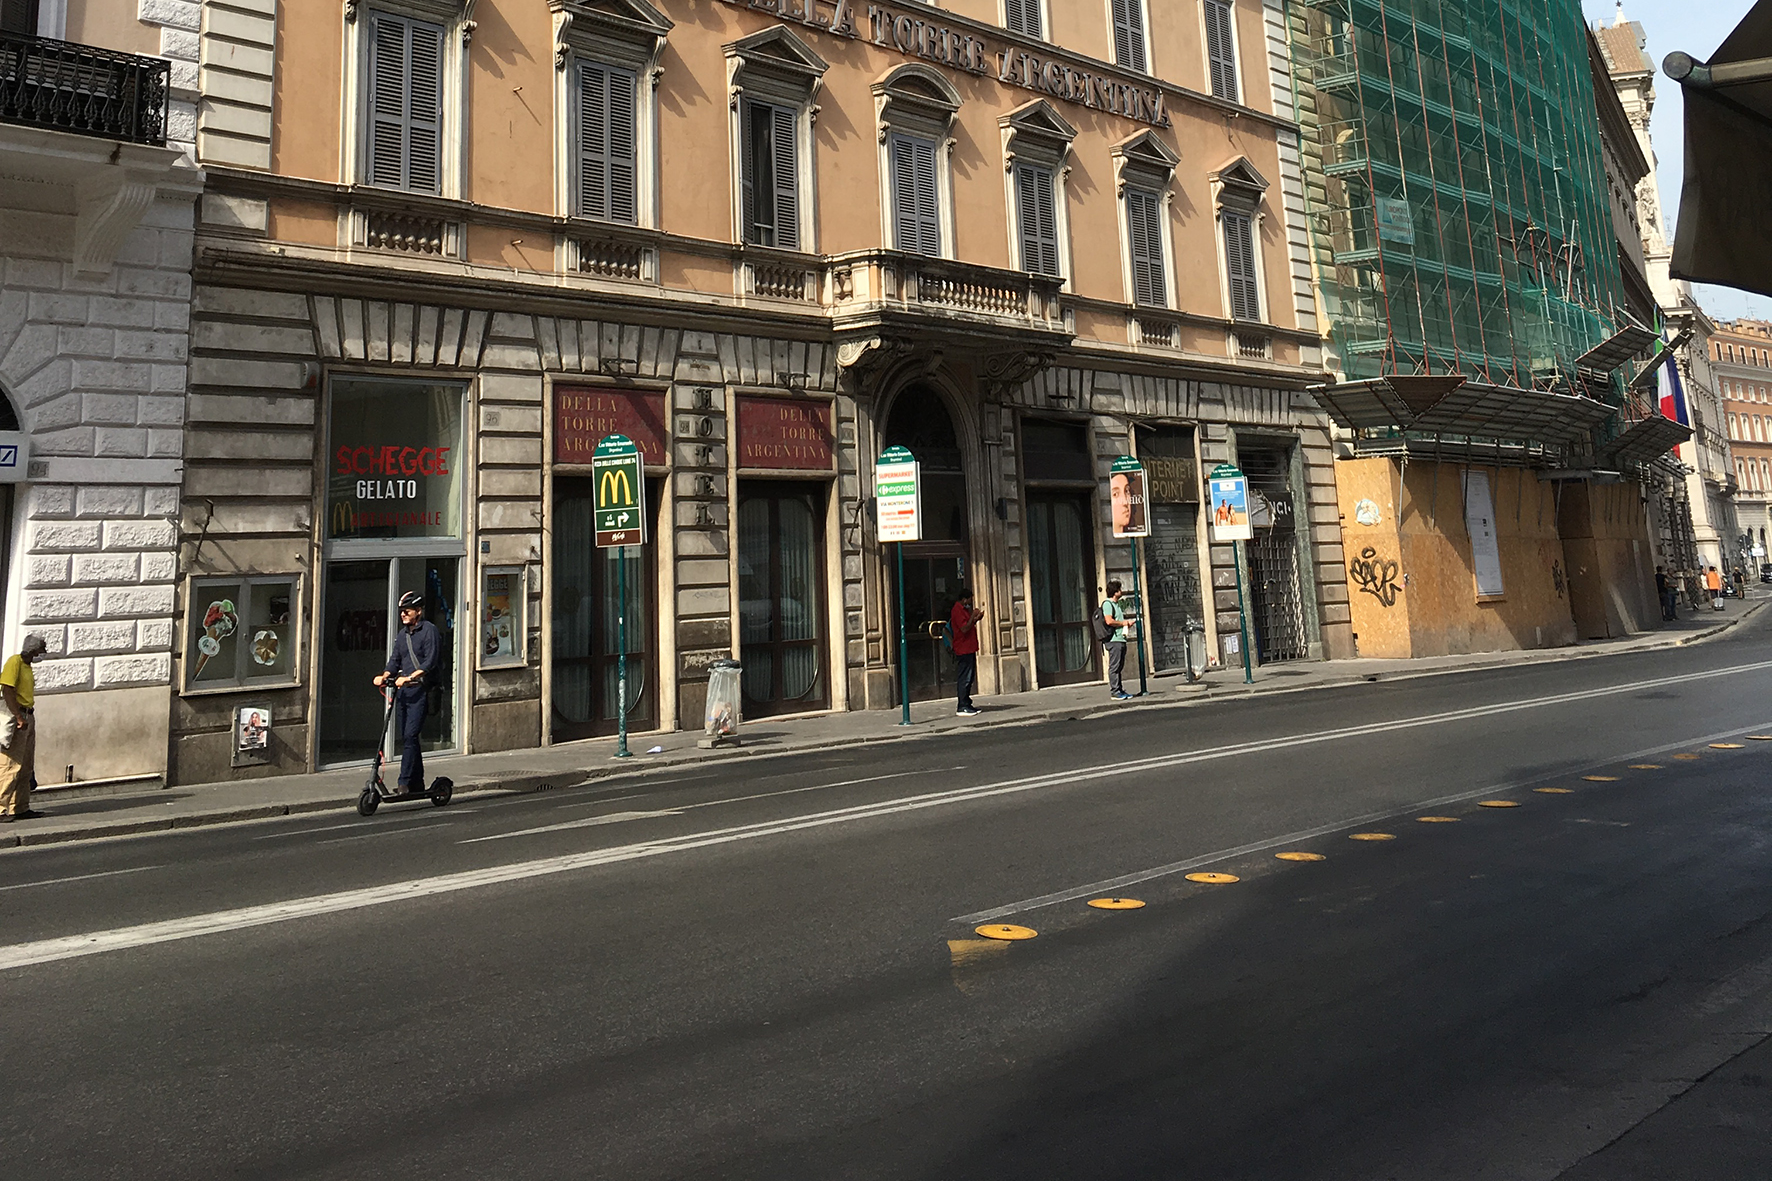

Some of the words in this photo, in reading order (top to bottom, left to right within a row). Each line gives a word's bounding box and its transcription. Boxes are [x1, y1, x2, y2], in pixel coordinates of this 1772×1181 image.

[868, 4, 988, 75] TORRE
[996, 47, 1173, 128] ARGENTINA
[562, 395, 617, 412] DELLA
[780, 407, 824, 423] DELLA
[562, 416, 618, 432] TORRE
[780, 425, 825, 441] TORRE
[745, 444, 826, 460] ARGENTINA
[336, 445, 451, 476] SCHEGGE
[879, 471, 914, 479] SUPERMARKET
[1142, 460, 1194, 478] NTERNET
[356, 479, 417, 499] GELATO
[889, 485, 914, 494] express
[1152, 480, 1184, 498] POINT
[351, 511, 442, 527] ARTIGIANALE
